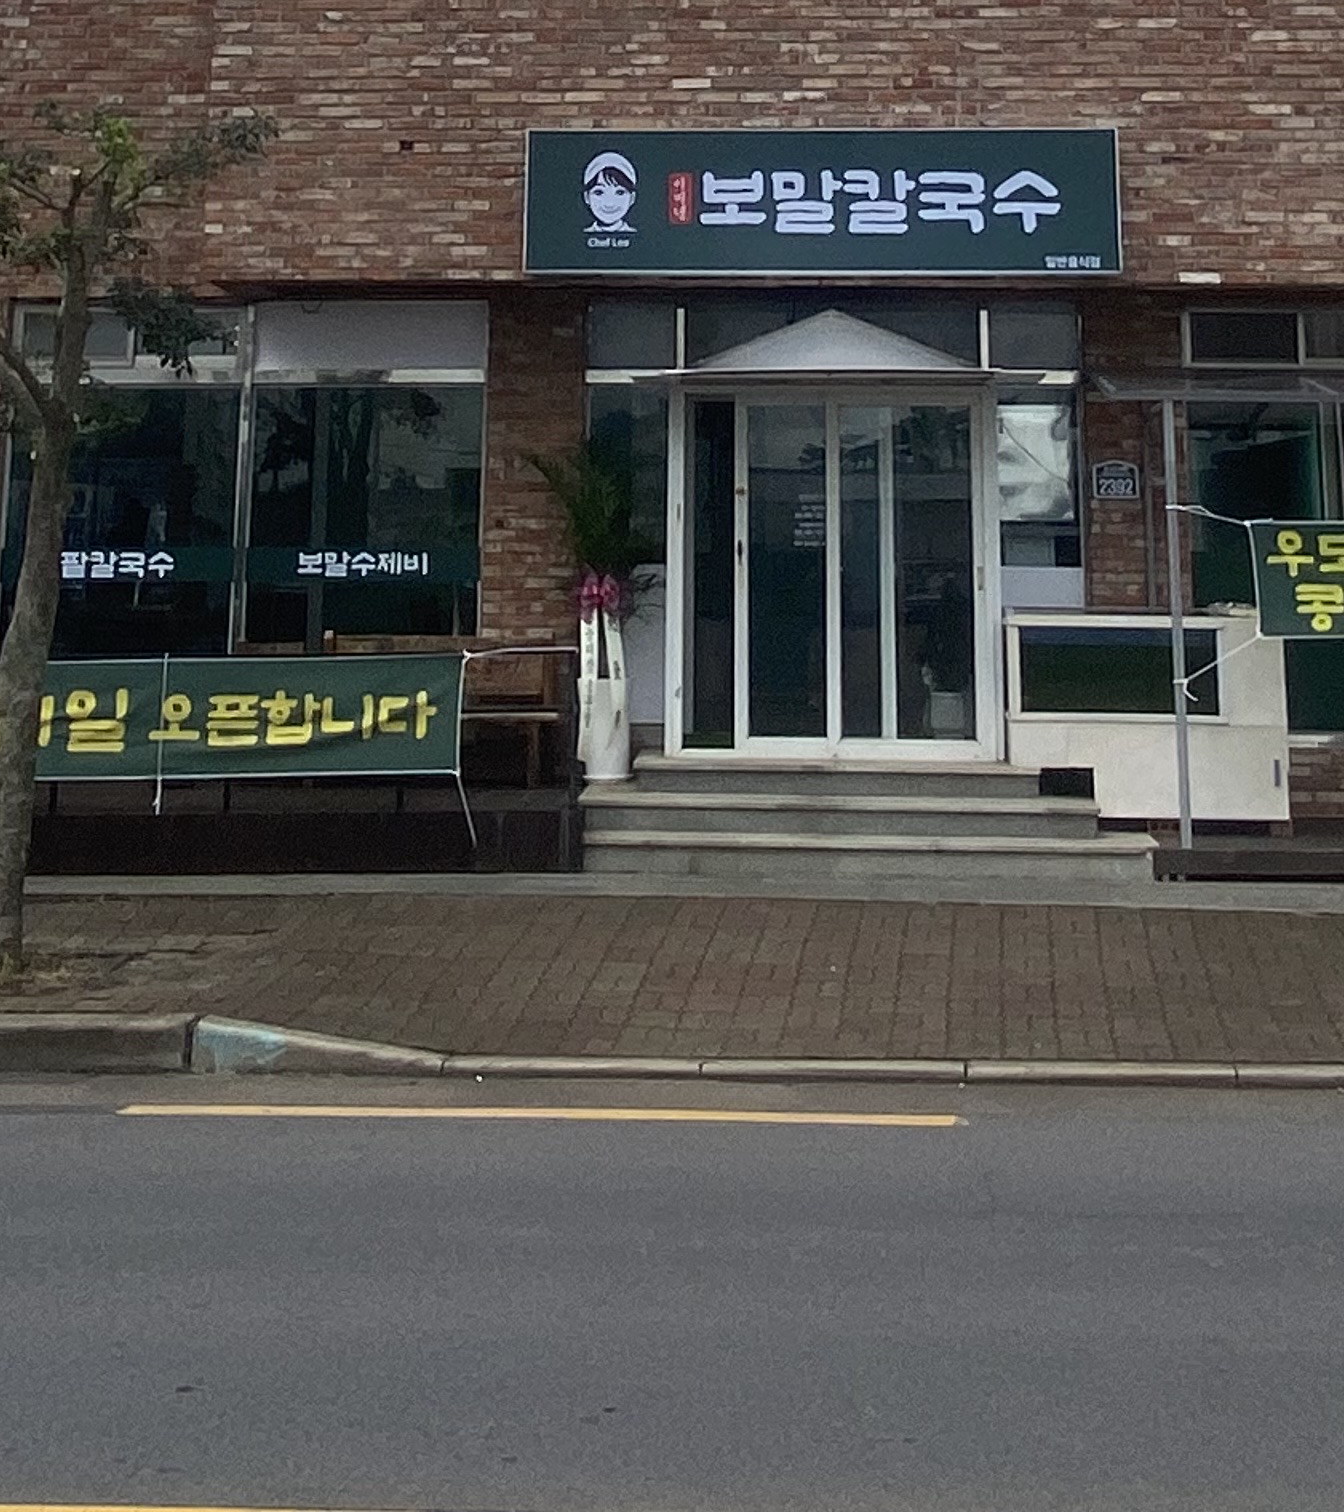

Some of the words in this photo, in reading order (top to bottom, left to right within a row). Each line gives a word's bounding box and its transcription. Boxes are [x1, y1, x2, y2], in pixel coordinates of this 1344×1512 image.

[699, 169, 1061, 235] 보말칼국수
[297, 551, 428, 577] 보말수제비
[148, 690, 438, 747] 오픈합니다
